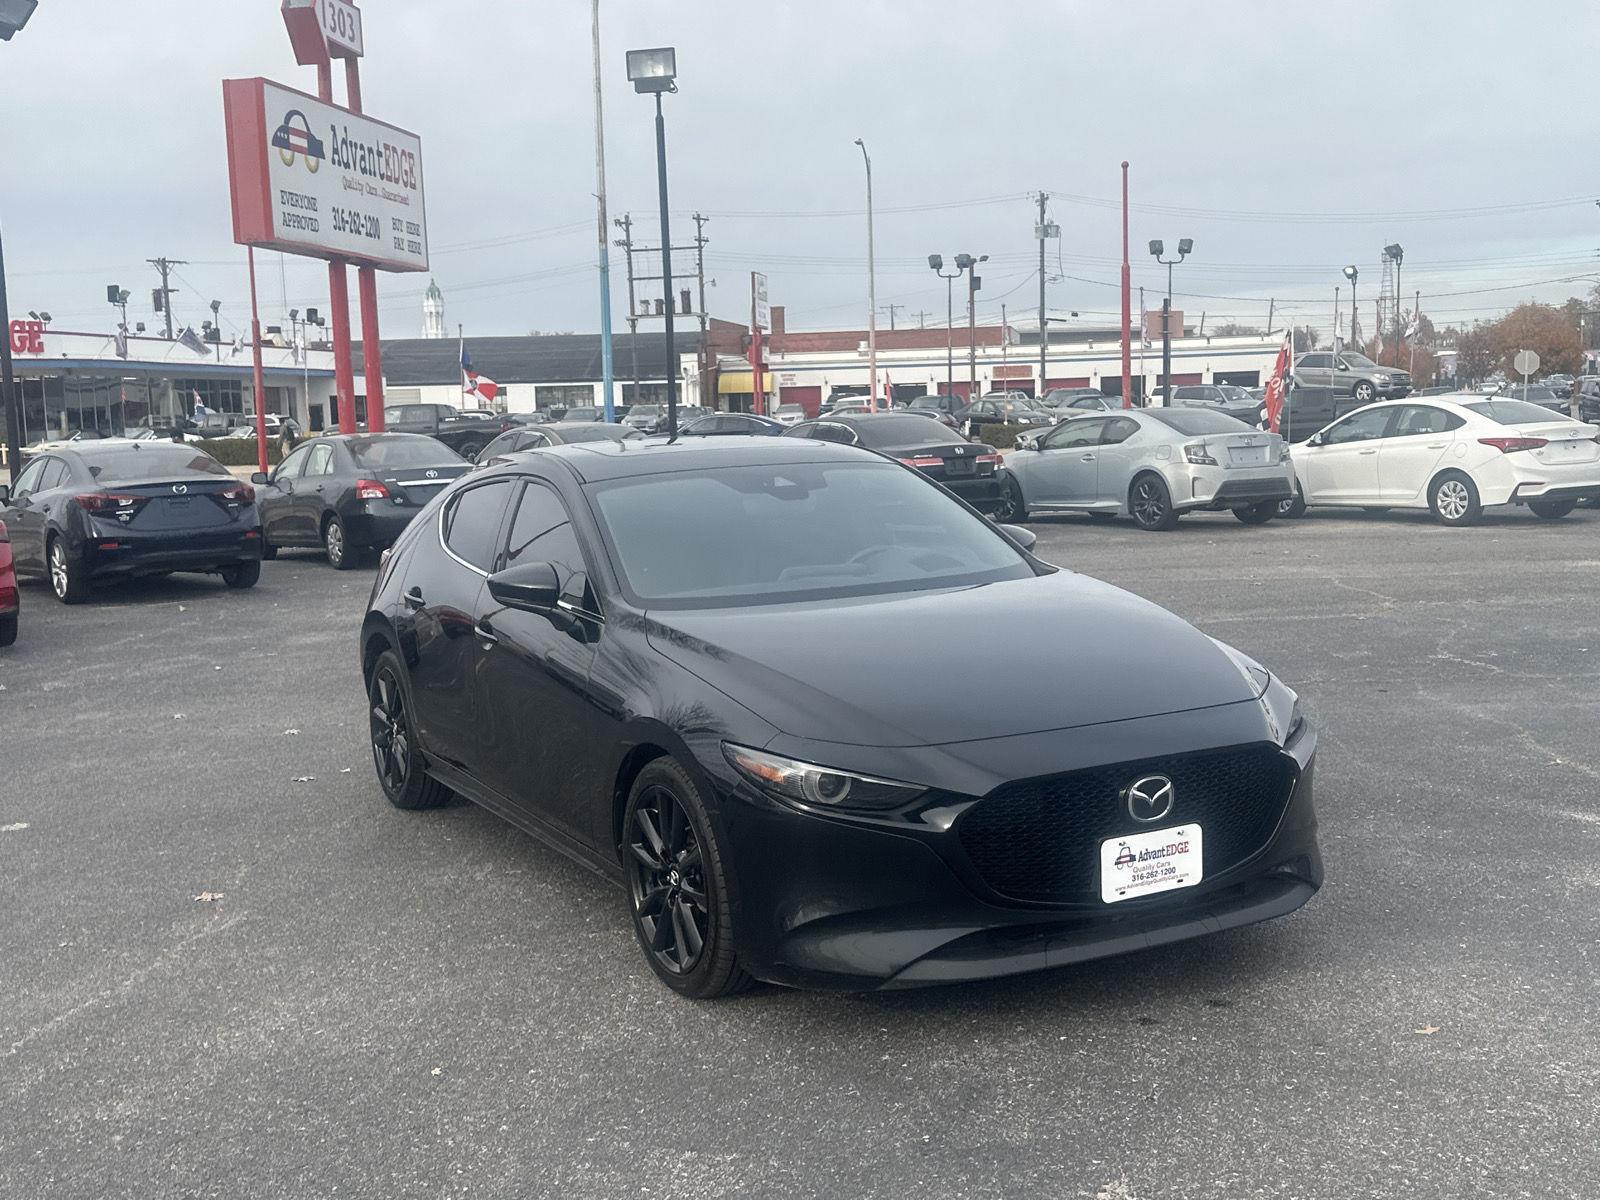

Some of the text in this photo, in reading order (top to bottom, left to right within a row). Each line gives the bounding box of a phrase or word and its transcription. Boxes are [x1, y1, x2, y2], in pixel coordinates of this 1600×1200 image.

[321, 0, 355, 42] 1303
[330, 125, 417, 190] AdvantEDGE
[342, 176, 364, 196] Quality
[280, 190, 318, 212] EVERYONE
[282, 212, 320, 233] APPROVED
[332, 207, 381, 240] 316-262-1200
[391, 217, 421, 237] BUY HERE
[393, 237, 422, 255] PAY HERE
[1138, 841, 1189, 862] AdvantEDGE
[1131, 866, 1177, 882] 316-262-1200
[1132, 860, 1171, 874] Quality Cars
